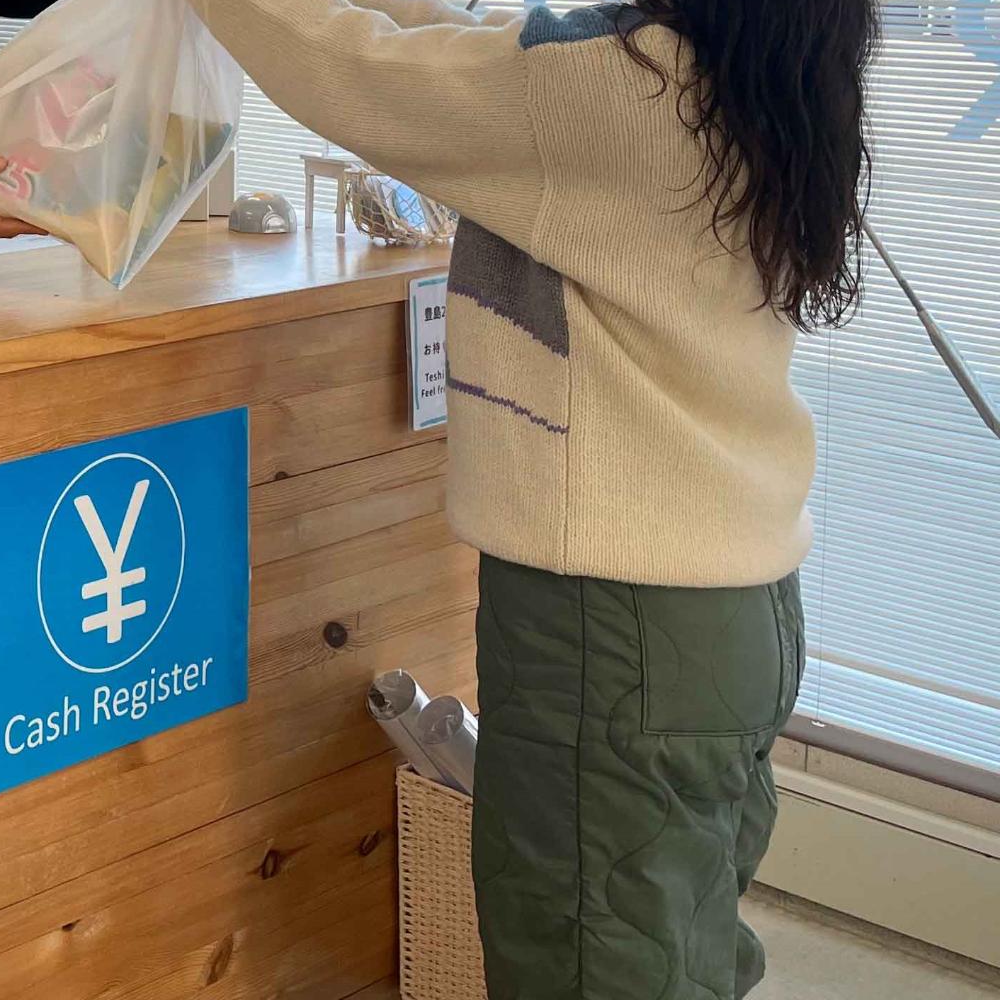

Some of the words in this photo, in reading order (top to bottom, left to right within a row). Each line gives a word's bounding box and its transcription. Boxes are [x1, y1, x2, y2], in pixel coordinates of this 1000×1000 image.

[424, 306, 446, 322] 豊島2
[424, 342, 445, 356] お持
[425, 370, 445, 383] Teshi
[421, 387, 436, 399] Feel
[4, 696, 80, 755] Cash
[93, 656, 213, 725] Register
